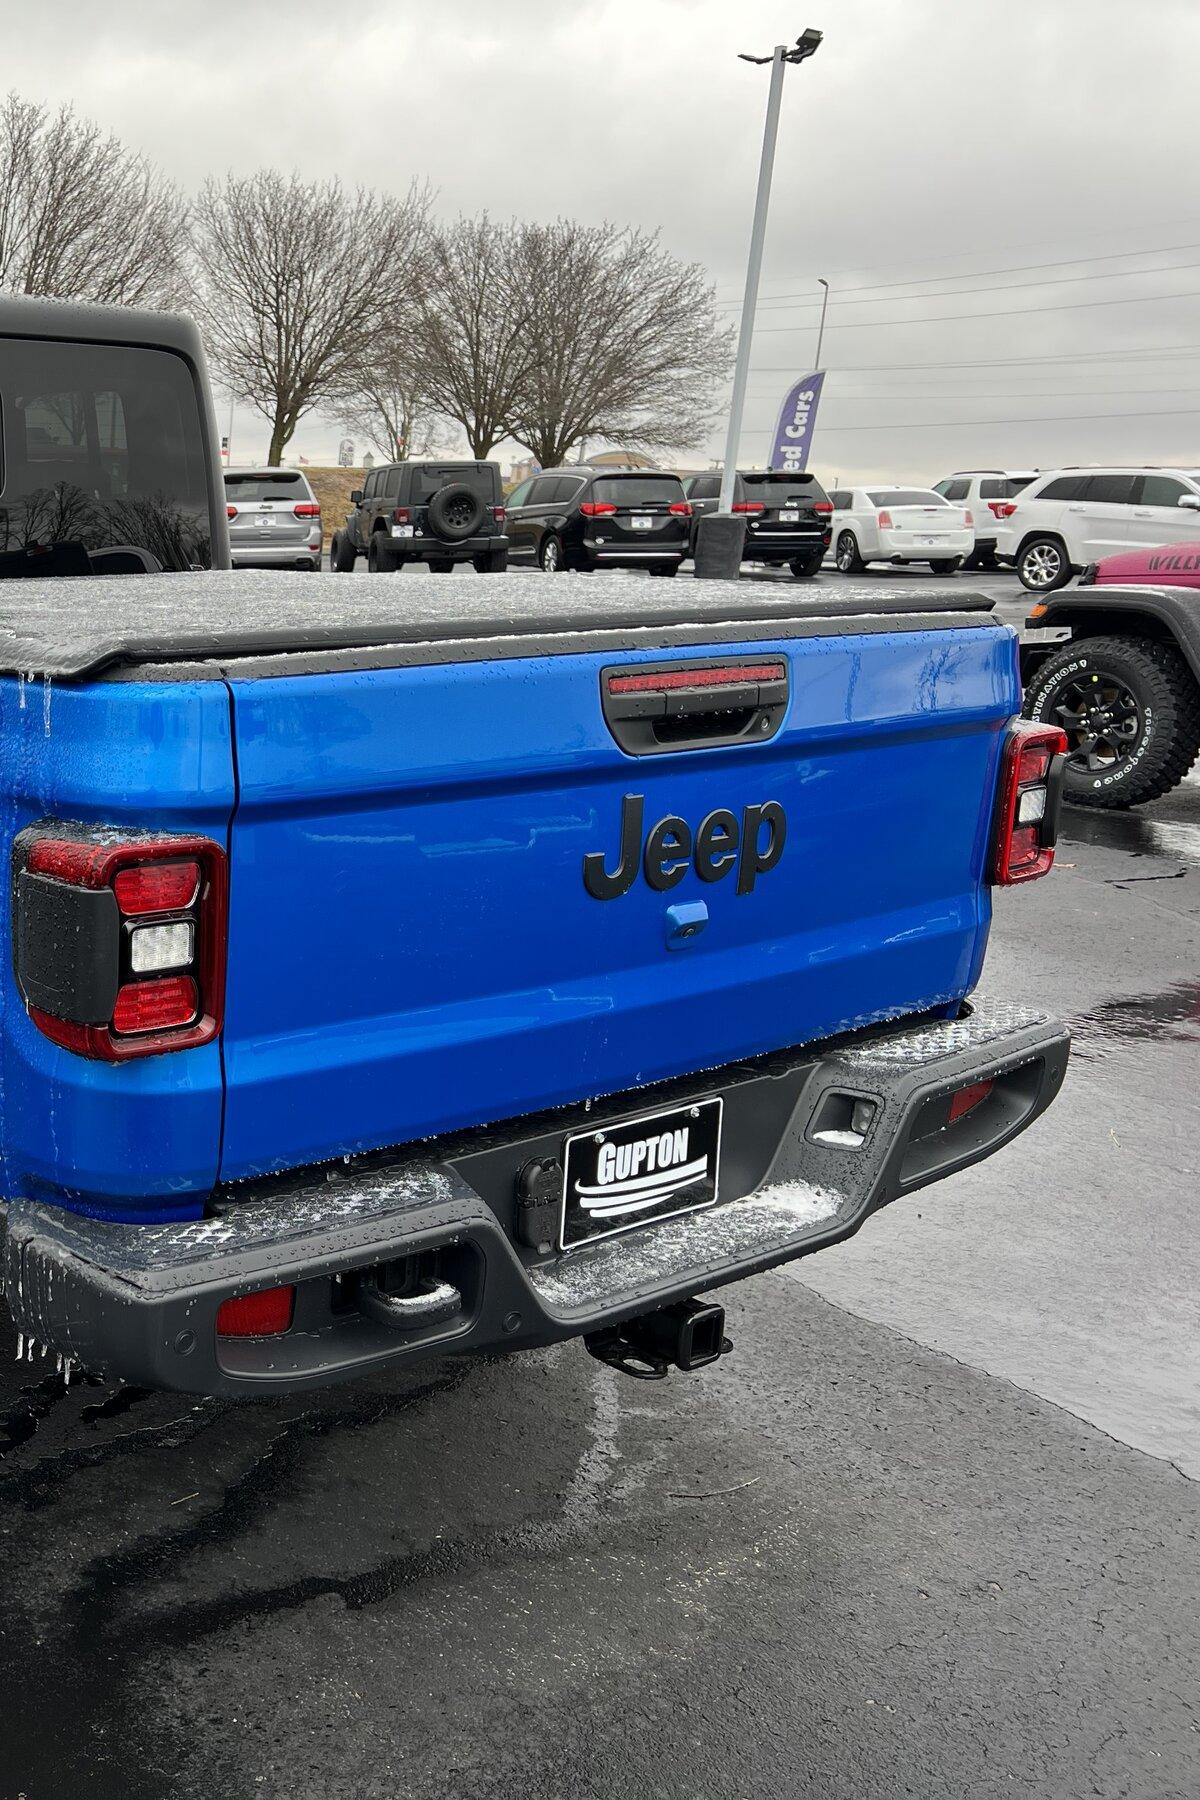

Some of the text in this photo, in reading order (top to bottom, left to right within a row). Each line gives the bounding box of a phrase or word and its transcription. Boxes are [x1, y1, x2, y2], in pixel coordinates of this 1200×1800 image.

[785, 390, 815, 439] Cars
[582, 793, 787, 900] Jeep
[597, 1127, 689, 1185] GUPTON
